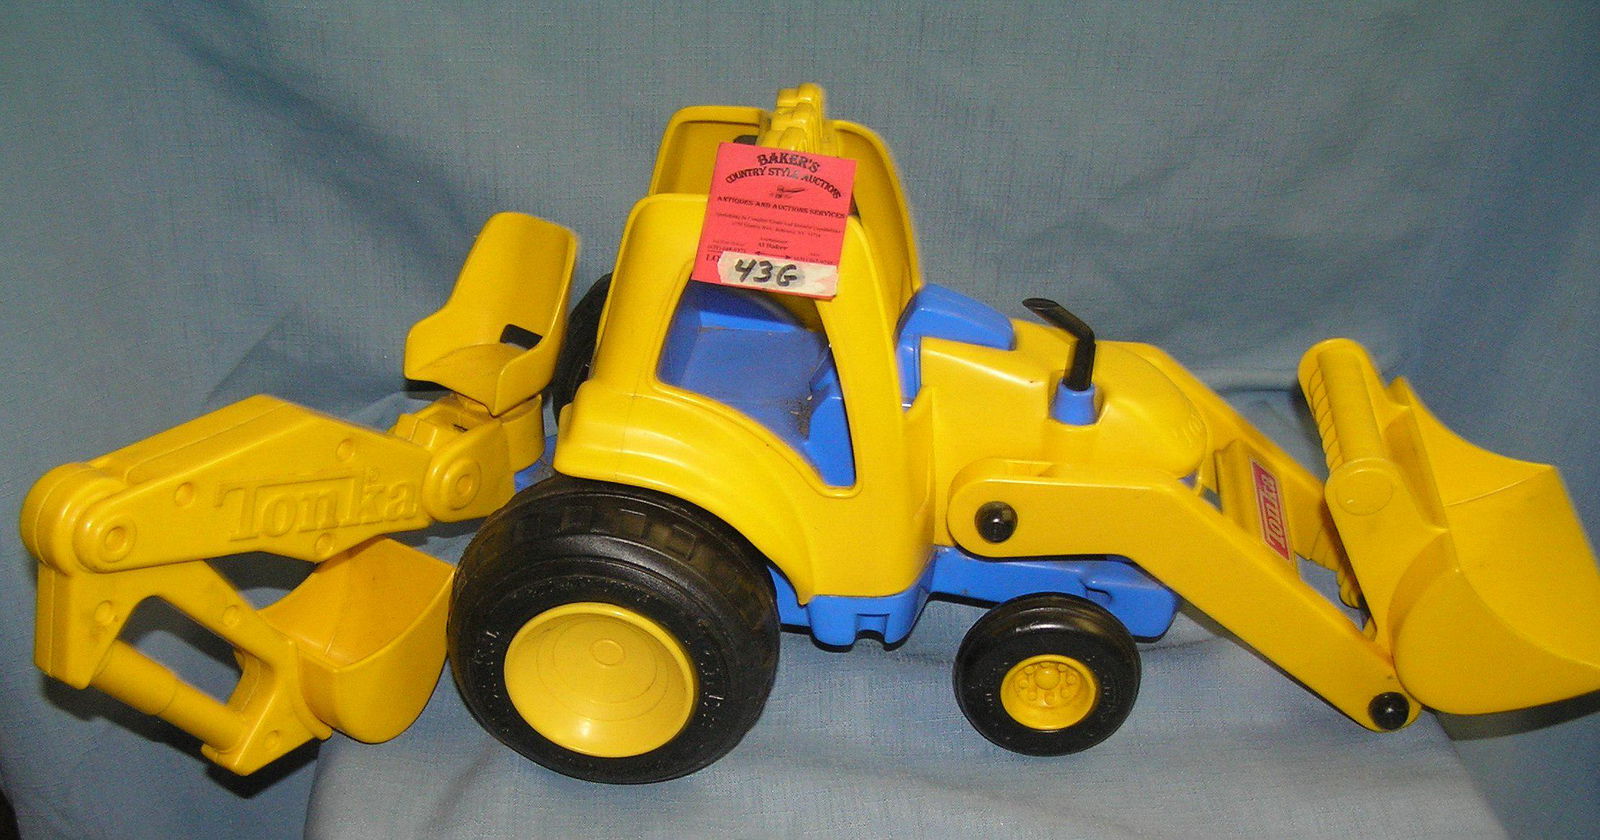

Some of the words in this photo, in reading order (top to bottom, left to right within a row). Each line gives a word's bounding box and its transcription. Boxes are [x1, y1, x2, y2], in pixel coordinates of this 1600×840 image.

[757, 152, 820, 174] BAKER'S
[725, 166, 766, 184] COUNTRY
[768, 167, 799, 180] STYLE
[801, 174, 842, 199] AUCTIONS
[717, 196, 754, 207] ANTIQUES
[756, 201, 771, 209] AND
[809, 209, 846, 219] SERVICES
[706, 254, 720, 264] LO
[214, 476, 418, 543] Tonka
